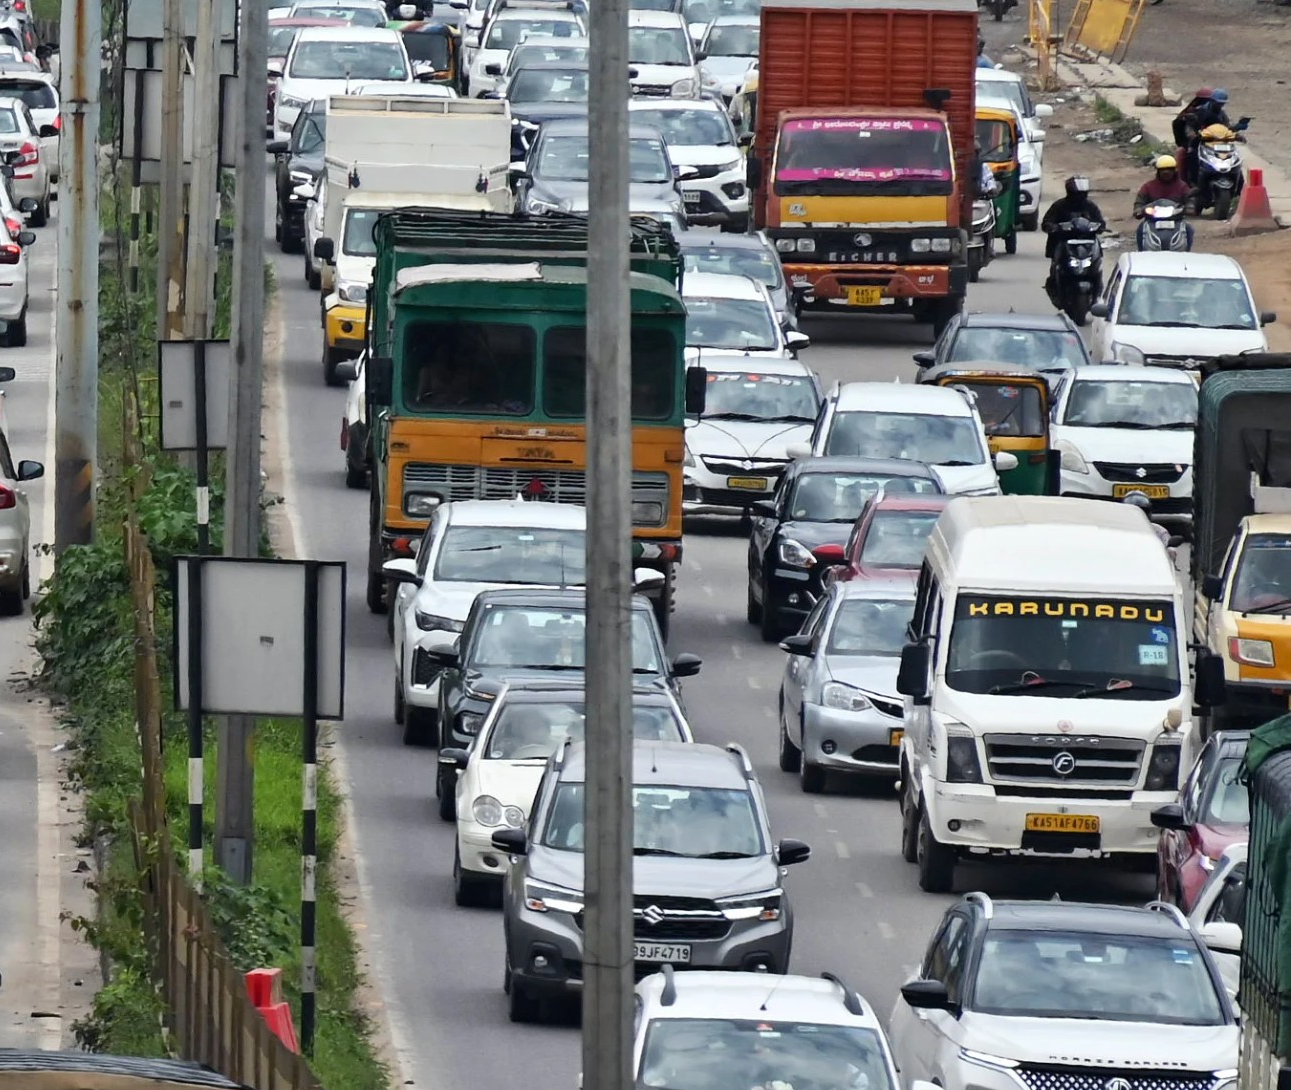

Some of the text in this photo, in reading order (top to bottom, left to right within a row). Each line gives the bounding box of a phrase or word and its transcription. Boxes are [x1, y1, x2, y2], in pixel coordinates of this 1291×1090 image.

[829, 252, 898, 262] EICHER
[969, 602, 1163, 622] KARUNADU
[1033, 817, 1097, 831] KA51AF4766
